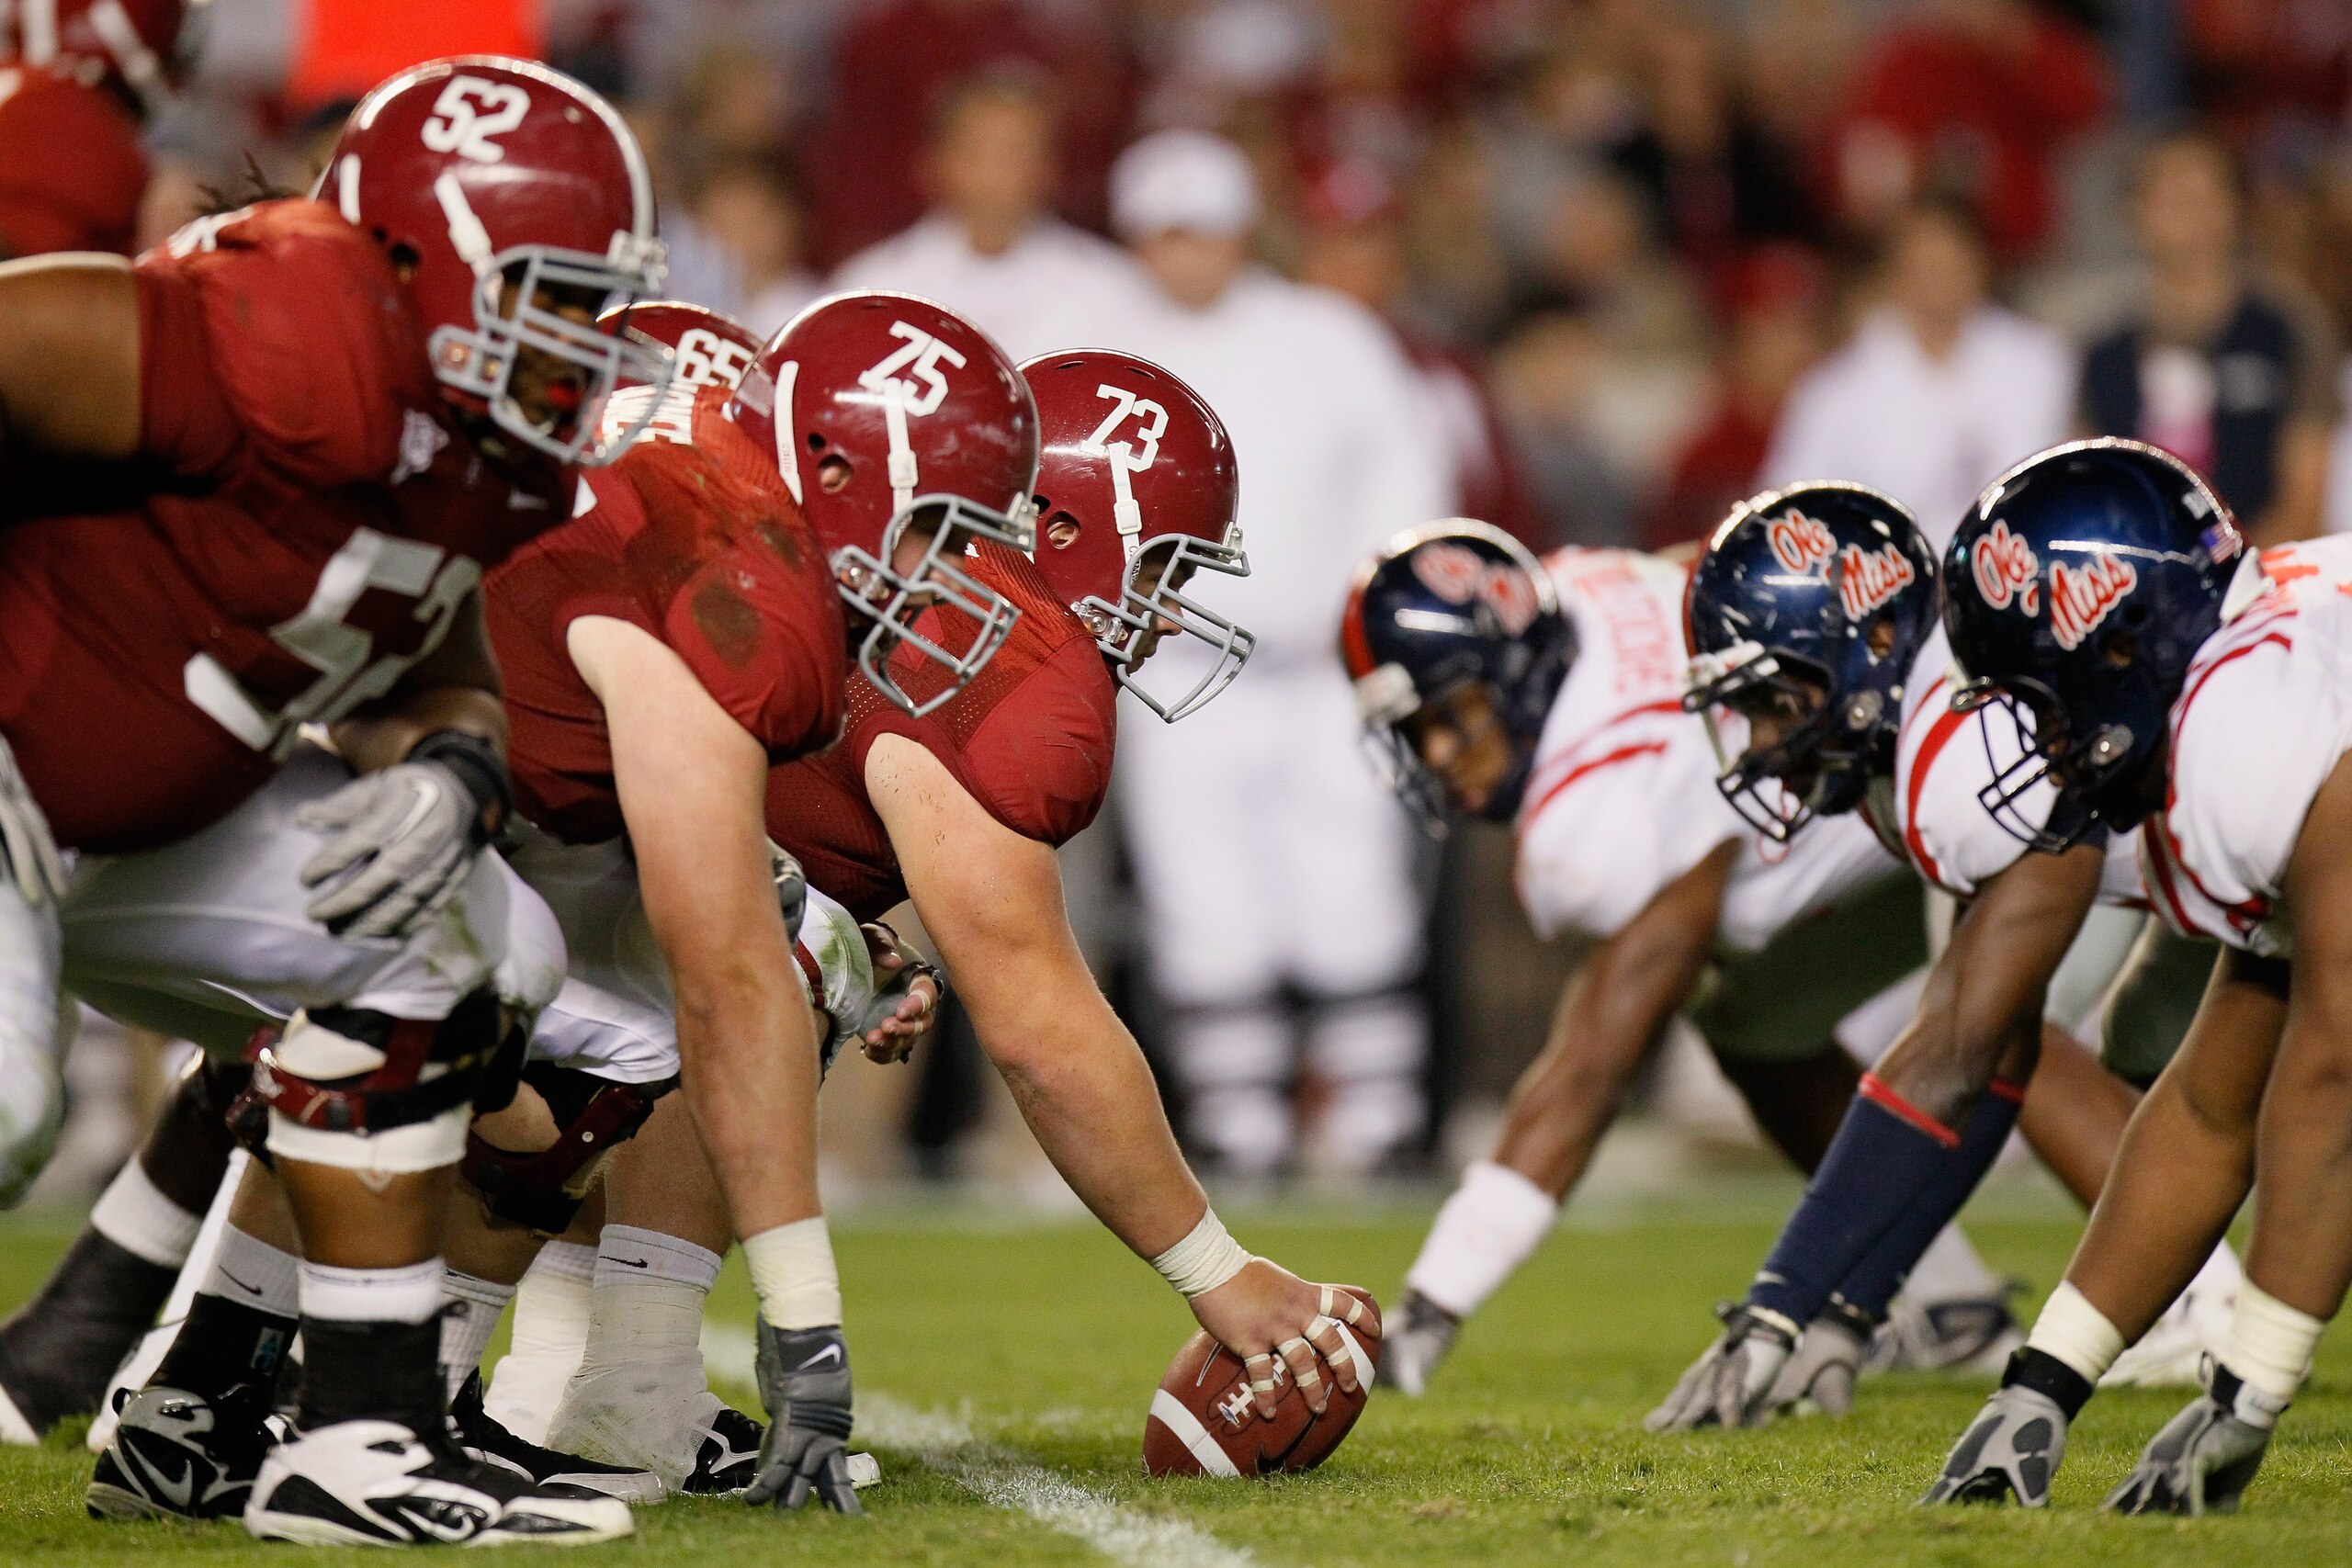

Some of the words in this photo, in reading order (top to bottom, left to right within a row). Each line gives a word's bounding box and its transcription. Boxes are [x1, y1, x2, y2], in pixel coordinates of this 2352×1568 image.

[420, 73, 532, 164] 52
[673, 328, 754, 390] 65
[857, 320, 967, 417] 75
[1080, 383, 1170, 472] 73
[1767, 507, 1838, 577] Ole
[1818, 541, 1916, 623] Miss
[1972, 518, 2039, 611] Ole
[2020, 549, 2138, 652] Miss
